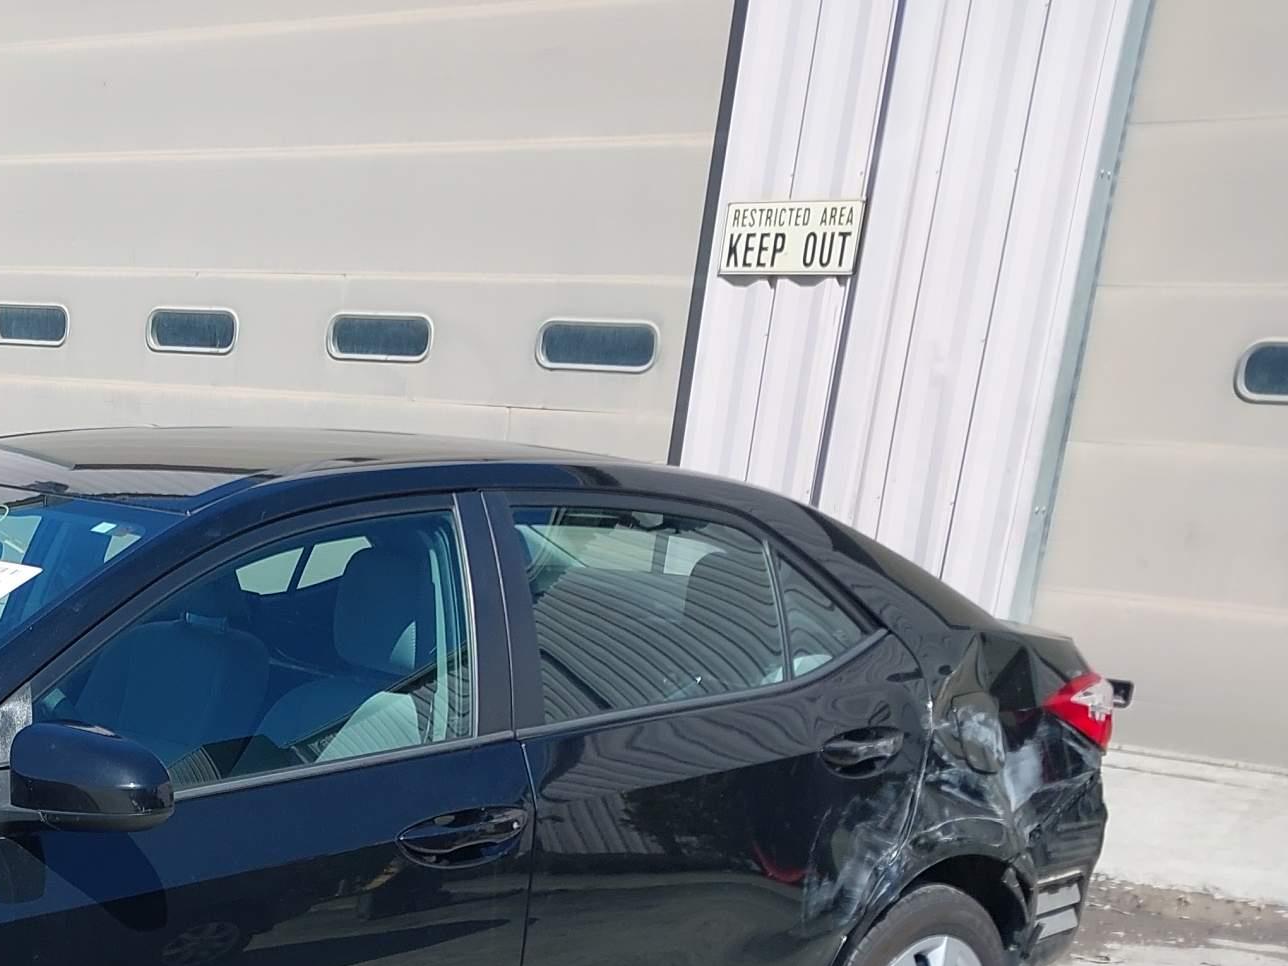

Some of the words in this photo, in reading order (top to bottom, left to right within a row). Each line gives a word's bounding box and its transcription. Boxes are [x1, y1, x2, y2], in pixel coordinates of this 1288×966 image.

[732, 207, 811, 228] RESTRICTED
[819, 206, 854, 226] AREA
[726, 232, 786, 268] KEEP
[802, 231, 852, 268] OUT
